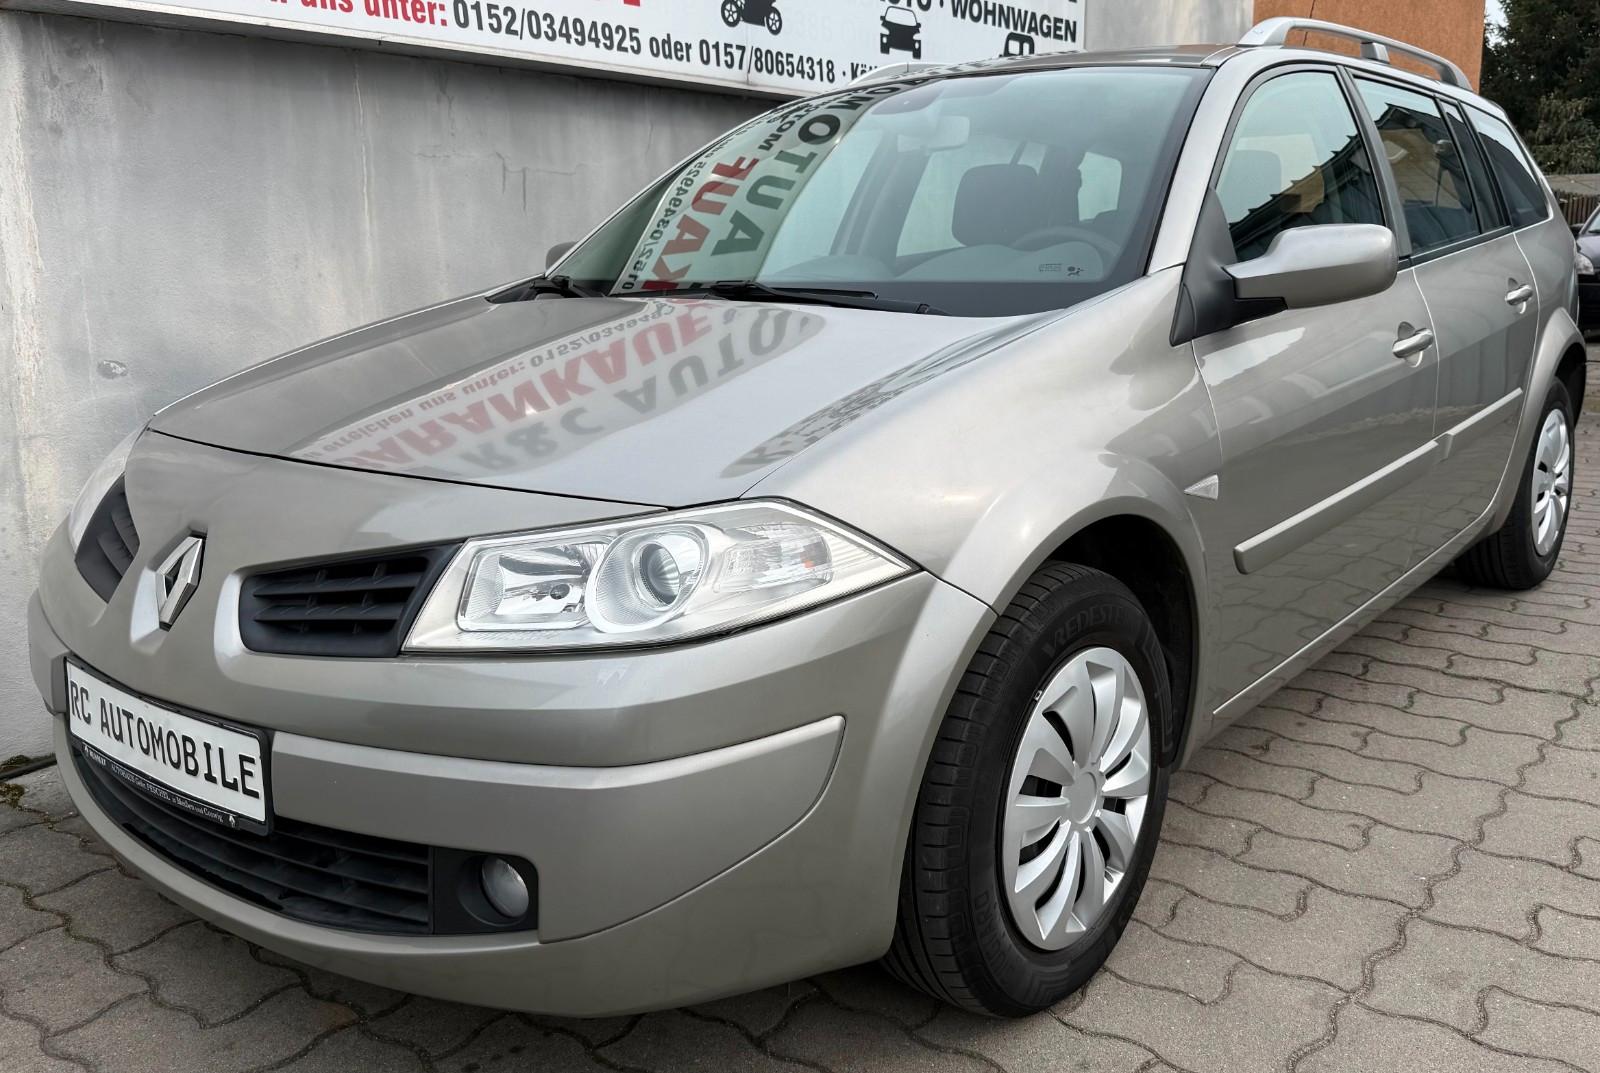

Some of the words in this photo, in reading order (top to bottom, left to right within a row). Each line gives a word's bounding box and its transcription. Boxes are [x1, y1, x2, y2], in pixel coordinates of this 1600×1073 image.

[365, 0, 447, 26] unter:
[454, 0, 641, 55] 0152/03494925
[649, 34, 692, 62] oder
[699, 39, 835, 84] 0157/80654318
[951, 0, 1077, 43] WOHNWAGEN
[69, 679, 92, 725] RC
[99, 697, 261, 800] AUTOMOBILE
